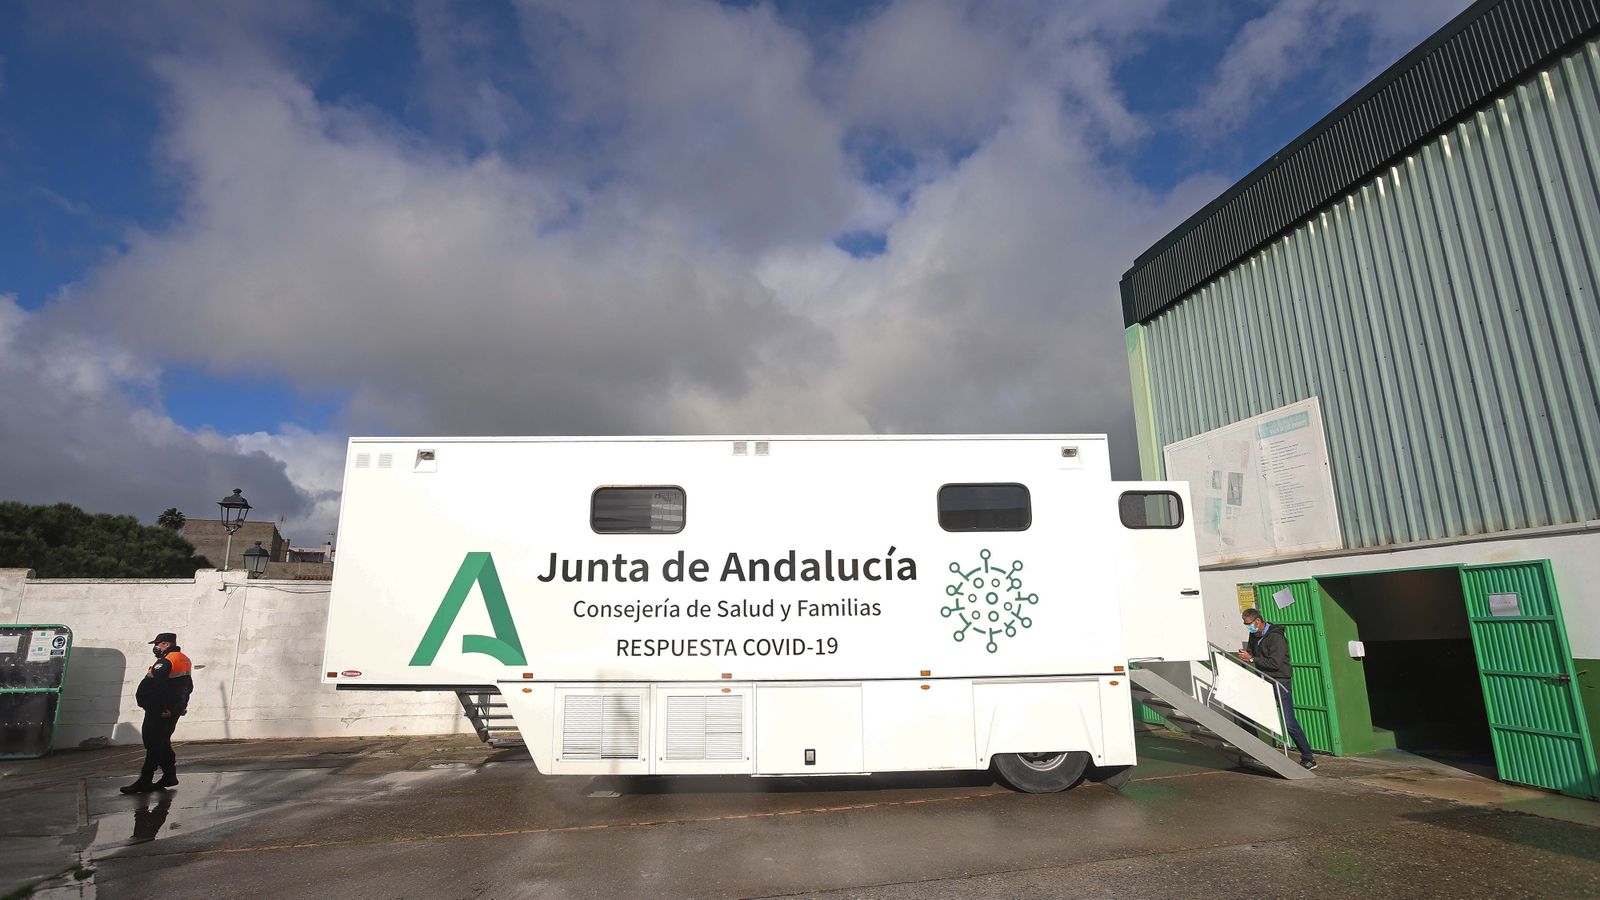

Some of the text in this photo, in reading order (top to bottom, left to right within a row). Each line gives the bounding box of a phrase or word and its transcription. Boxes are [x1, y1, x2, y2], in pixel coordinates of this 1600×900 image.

[537, 546, 917, 583] Junta de Andalucía
[573, 598, 881, 622] Consejería de Salud y Familias
[616, 637, 839, 657] RESPUESTA COVID-19
